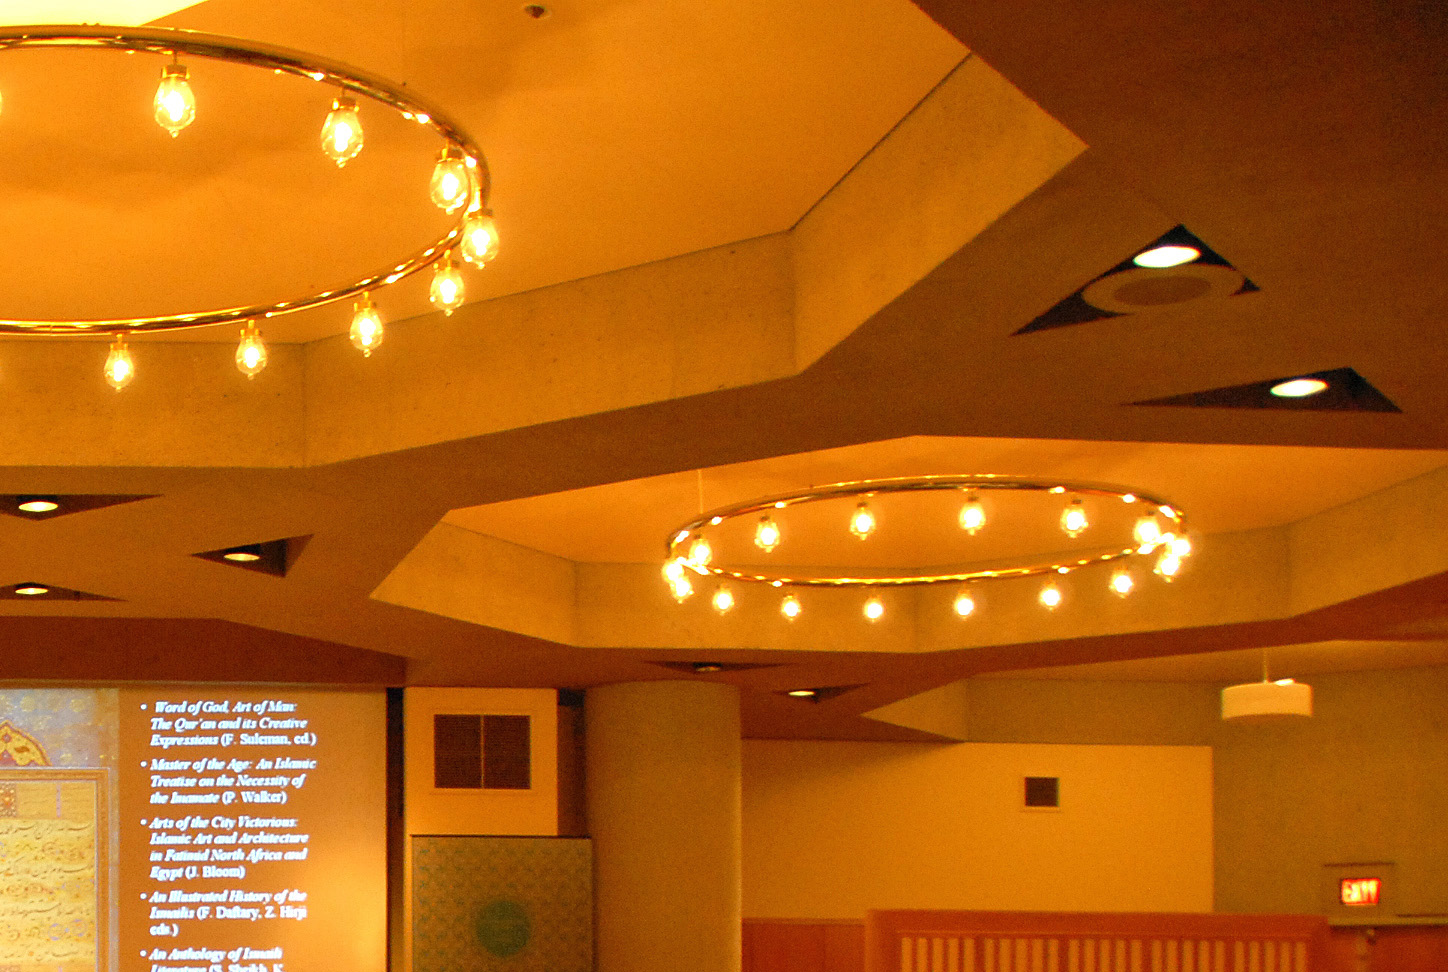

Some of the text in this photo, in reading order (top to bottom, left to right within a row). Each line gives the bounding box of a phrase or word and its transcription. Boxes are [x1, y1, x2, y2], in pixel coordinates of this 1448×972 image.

[155, 701, 185, 713] Word
[188, 702, 201, 715] of
[232, 701, 251, 713] Art
[254, 702, 267, 715] of
[151, 718, 171, 729] The
[218, 718, 241, 729] and
[243, 718, 257, 729] its
[259, 718, 308, 729] Creative
[150, 735, 218, 748] Expressions
[221, 733, 236, 746] (F.
[150, 758, 191, 770] Master
[193, 759, 206, 772] of
[207, 758, 225, 770] the
[256, 758, 272, 770] An
[275, 758, 316, 770] Islamic
[150, 774, 306, 788] Treatise on the Necessity of
[150, 792, 168, 804] the
[222, 792, 238, 804] (P.
[241, 792, 287, 804] Walker)
[149, 817, 174, 828] Arts
[176, 817, 190, 831] of
[191, 817, 209, 828] the
[211, 817, 235, 830] City
[150, 832, 309, 844] Islamic Art and Architecture
[150, 848, 308, 863] in Fatimid North Africa and
[150, 866, 184, 881] Egypt
[202, 866, 245, 878] Bloom)
[149, 890, 307, 903] An Illustrated History of the
[197, 907, 213, 919] (F.
[149, 948, 167, 960] An
[168, 948, 226, 962] Anthology
[228, 948, 242, 961] of
